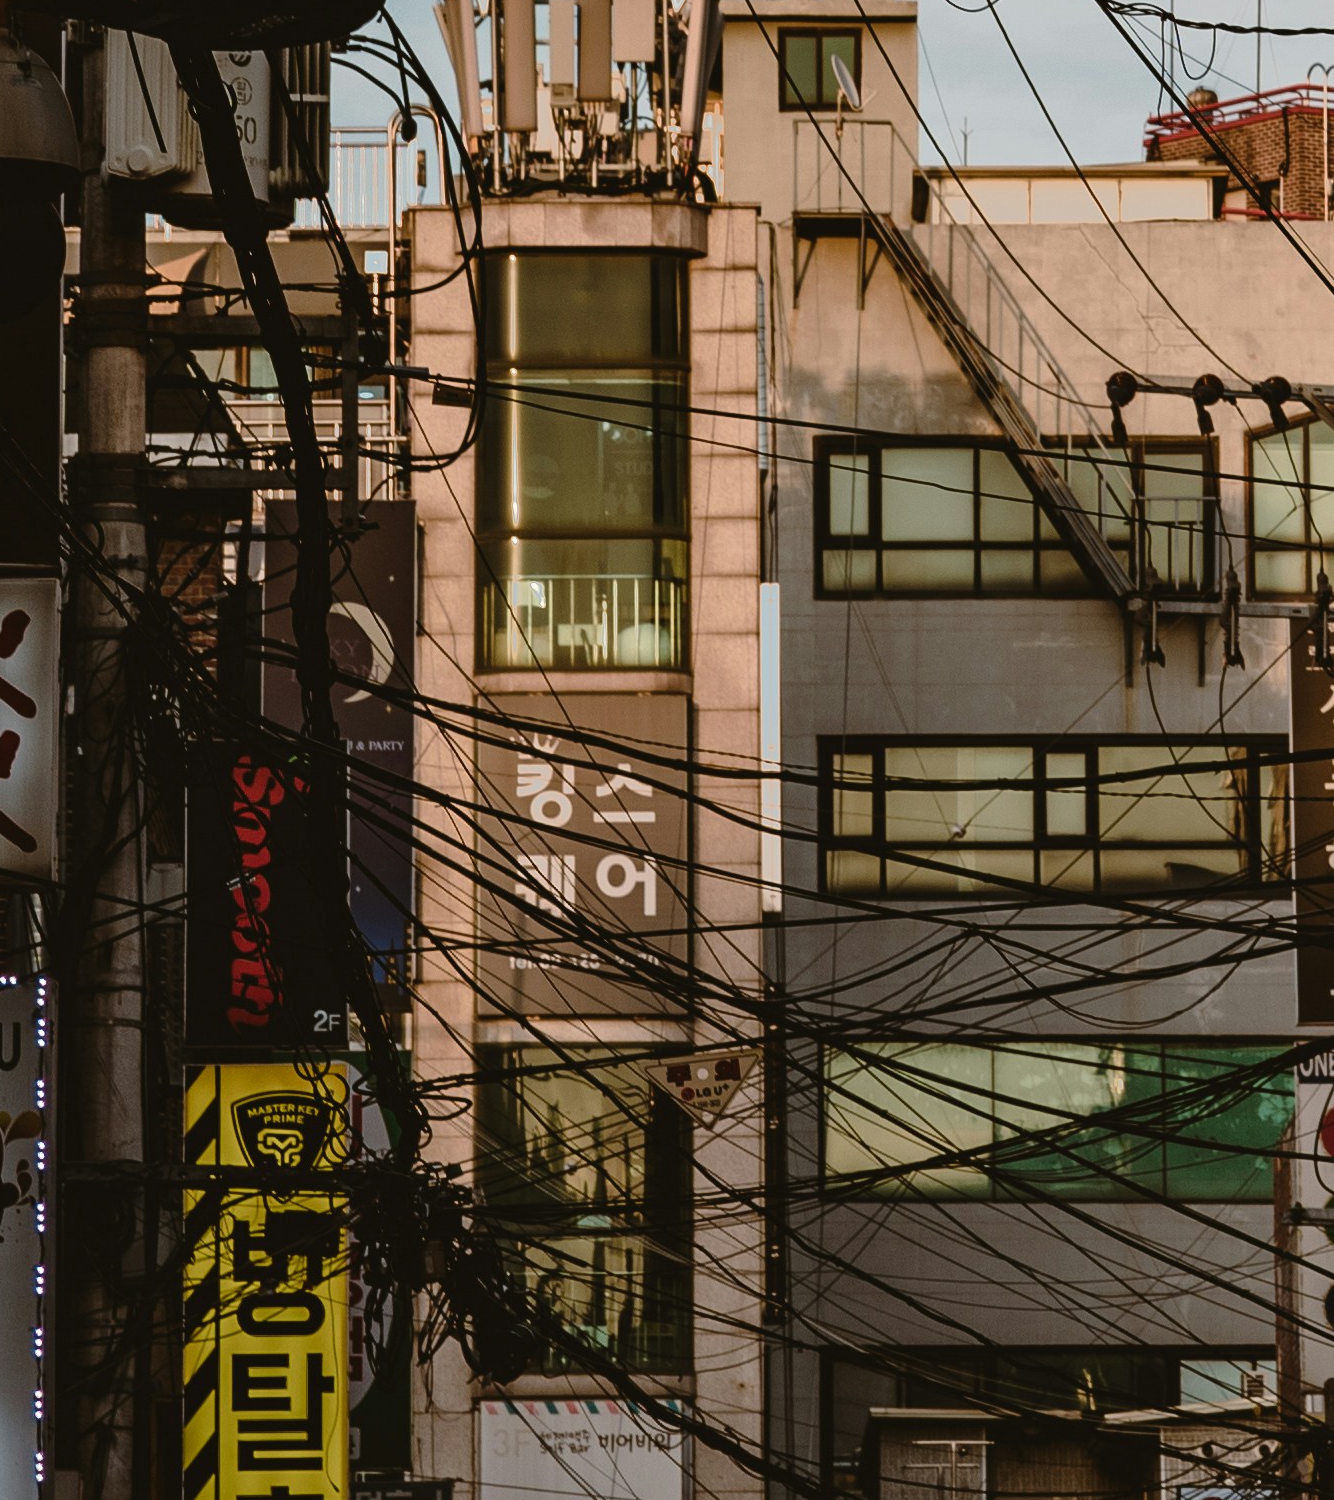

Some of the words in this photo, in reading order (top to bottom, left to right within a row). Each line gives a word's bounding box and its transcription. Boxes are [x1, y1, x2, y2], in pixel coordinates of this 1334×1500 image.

[368, 740, 405, 752] PARTY
[515, 761, 657, 824] 킹스
[313, 1009, 342, 1033] 2F
[666, 1058, 742, 1088] 주의
[246, 1102, 295, 1119] MASTER
[296, 1102, 321, 1119] KEY
[263, 1114, 305, 1126] PRIME
